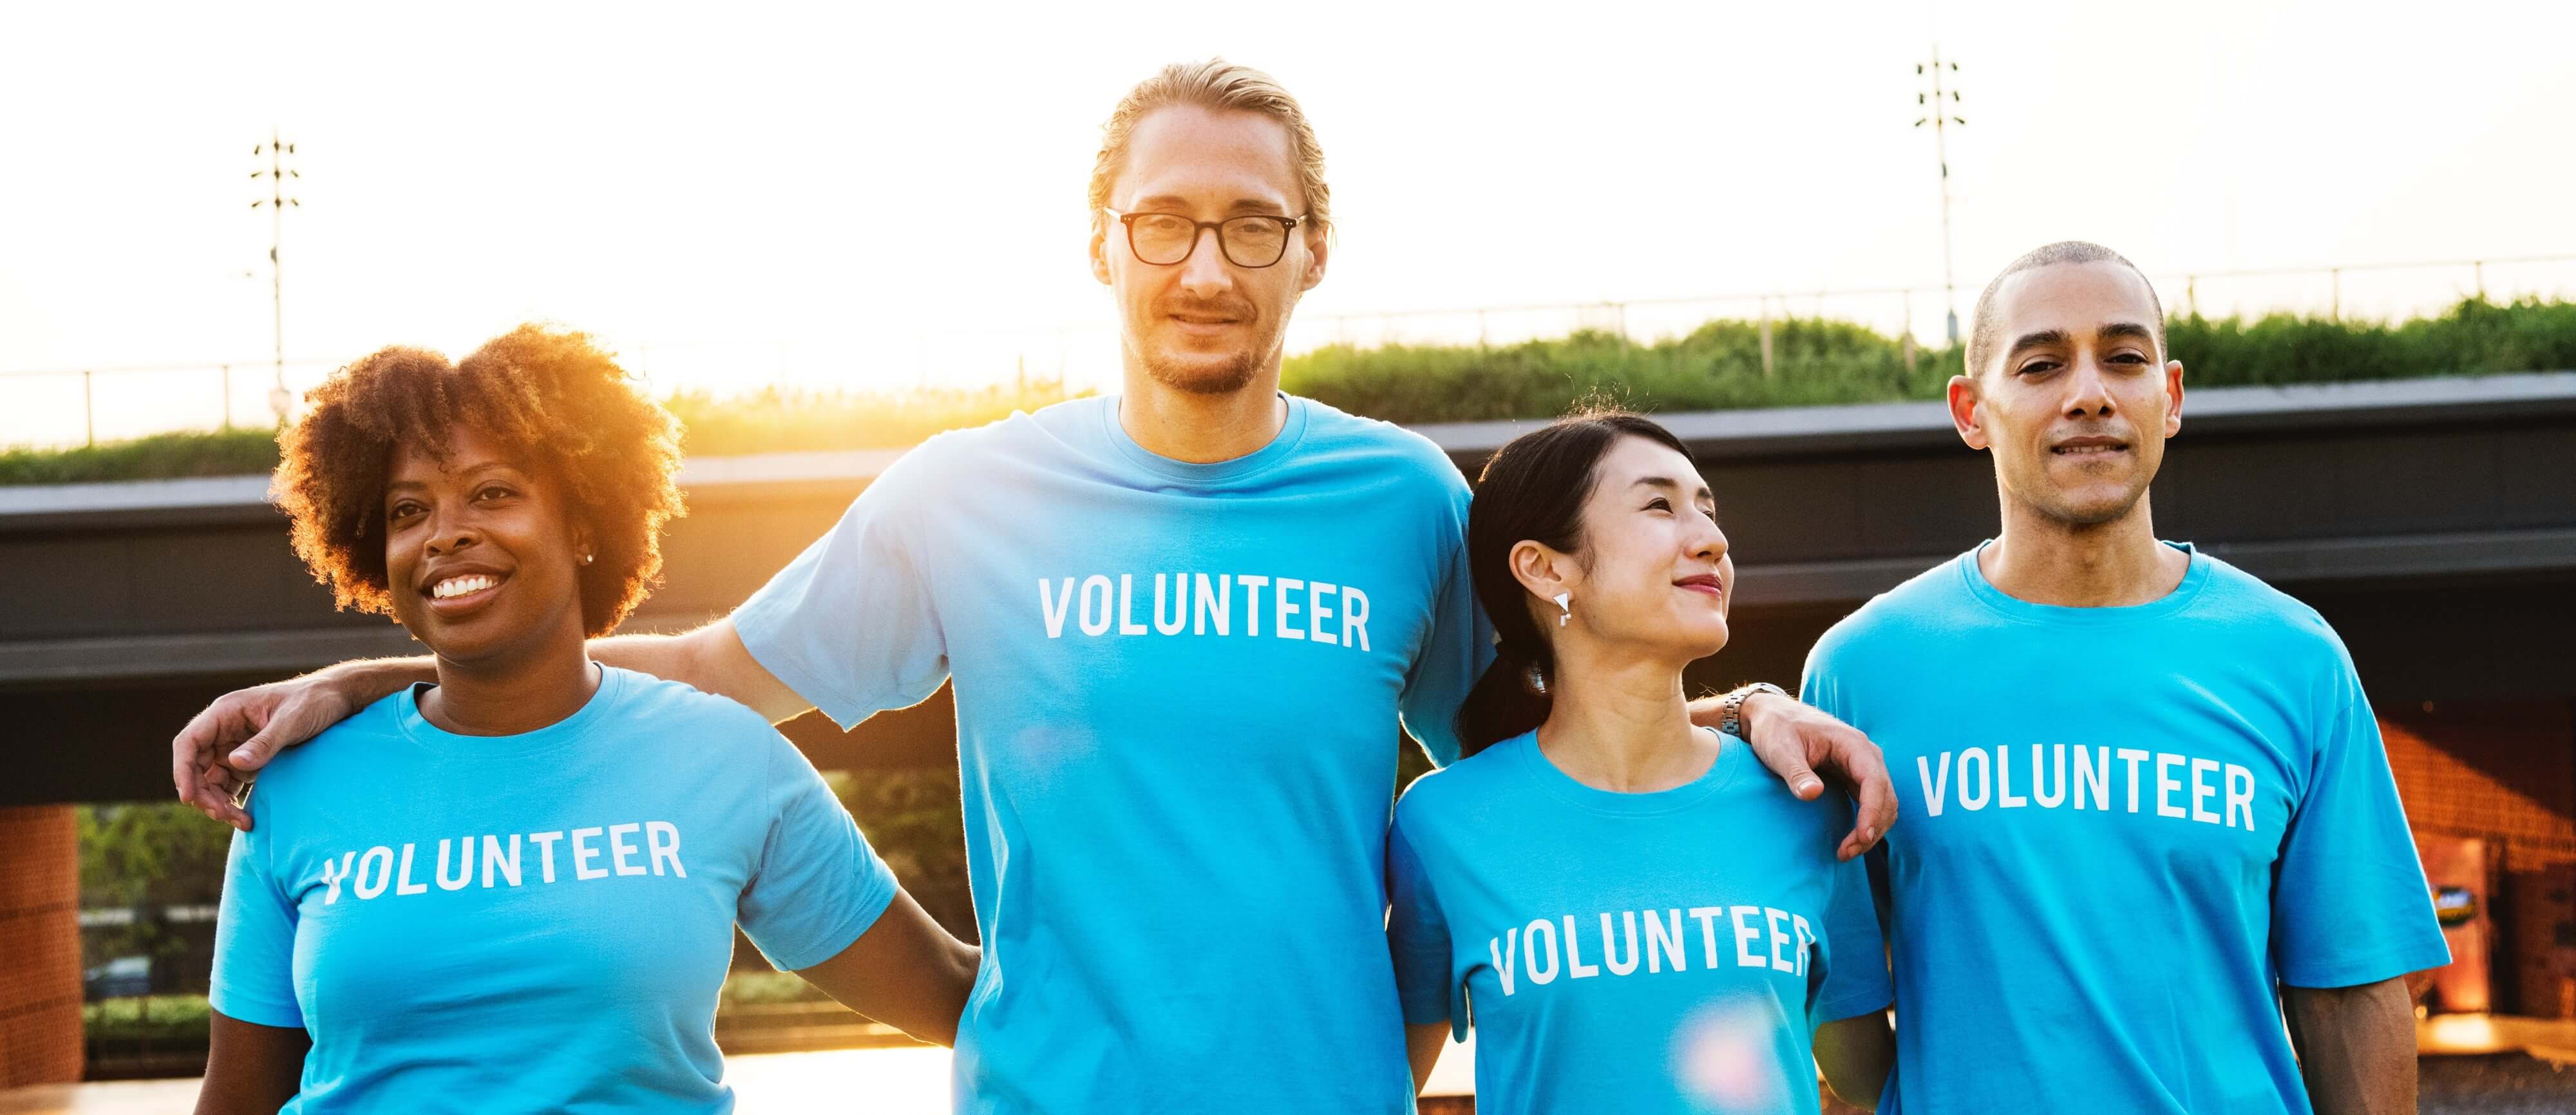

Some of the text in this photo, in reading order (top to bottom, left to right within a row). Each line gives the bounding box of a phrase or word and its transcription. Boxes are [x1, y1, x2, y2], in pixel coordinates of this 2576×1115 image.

[1038, 573, 1370, 652] VOLUNTEER
[1917, 743, 2255, 832] VOLUNTEER
[321, 821, 687, 905] VOLUNTEER
[1490, 906, 1815, 996] VOLUNTEER
